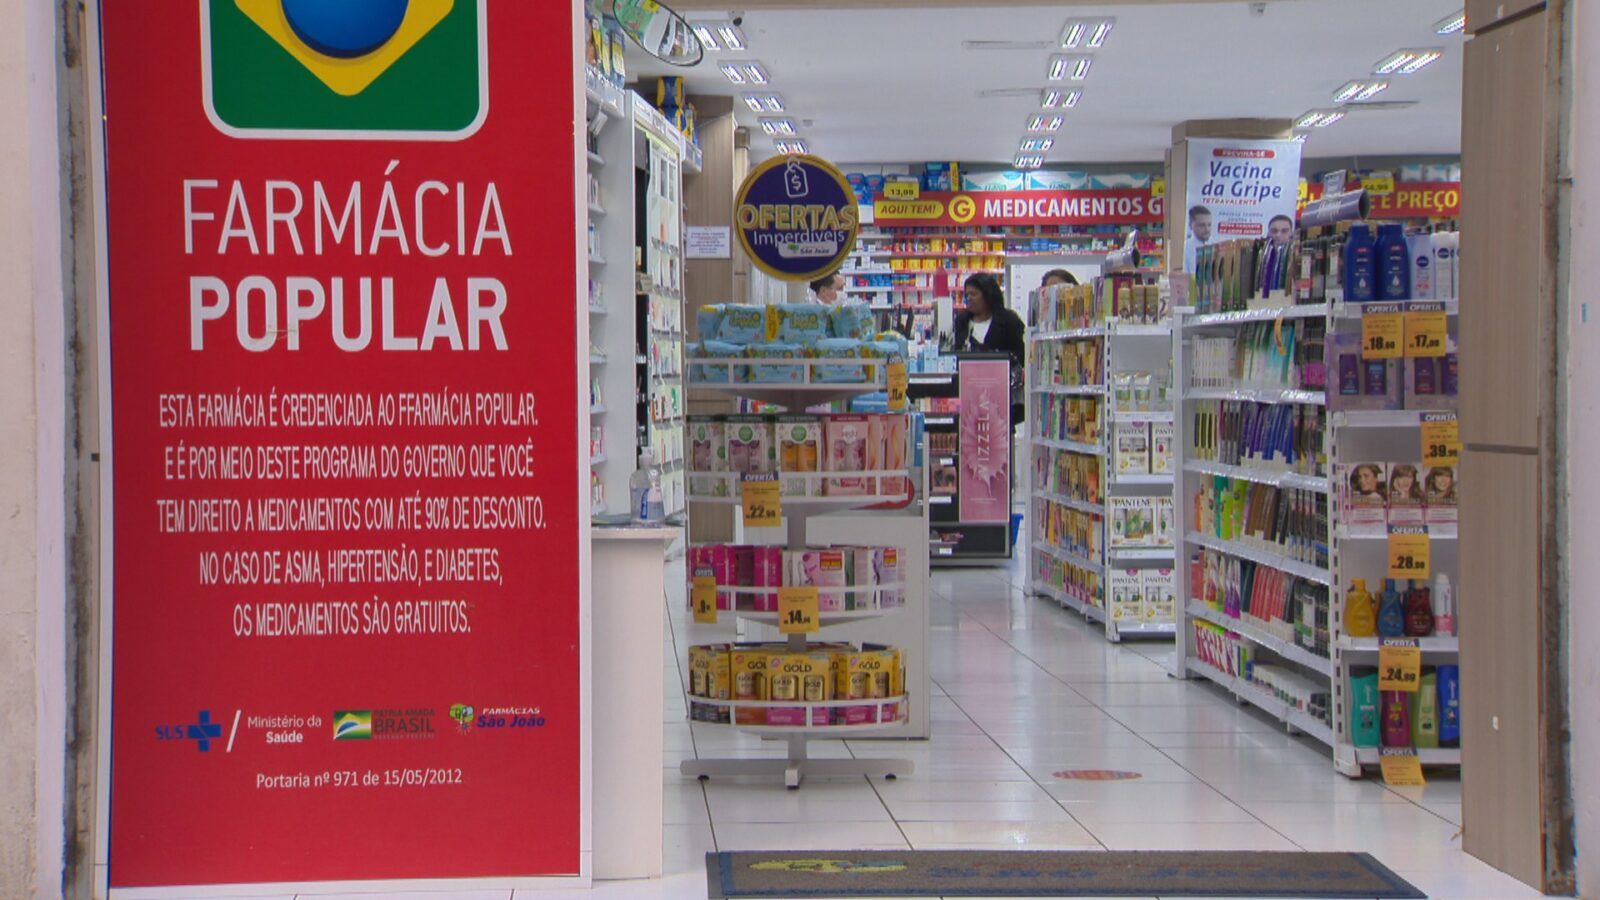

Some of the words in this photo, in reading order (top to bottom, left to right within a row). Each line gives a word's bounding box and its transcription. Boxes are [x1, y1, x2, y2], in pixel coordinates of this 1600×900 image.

[1222, 149, 1266, 158] PREVINA-SE
[1210, 161, 1272, 179] Vacina
[890, 188, 914, 197] 13,99
[1201, 179, 1225, 196] da
[1231, 180, 1282, 202] Gripe
[183, 159, 513, 257] FARMÁCIA
[983, 197, 1143, 218] MEDICAMENTOS
[1148, 197, 1165, 216] G
[1397, 190, 1458, 212] PREÇO
[880, 204, 908, 214] AQUI
[911, 203, 937, 214] TEM!
[953, 199, 971, 218] G
[737, 204, 857, 231] OFERTAS
[190, 275, 509, 352] POPULAR
[1367, 305, 1399, 313] OFERTA
[1410, 303, 1441, 311] OFERTA
[160, 394, 195, 427] ESTA
[199, 387, 266, 427] FARMÁCIA
[270, 387, 278, 427] É
[282, 394, 373, 426] CREDENCIADA
[378, 394, 395, 426] AO
[399, 387, 472, 426] FFARMÁCIA
[476, 393, 538, 426] POPULAR.
[1425, 413, 1457, 421] OFERTA
[165, 446, 174, 479] E
[178, 440, 186, 479] É
[190, 446, 217, 479] POR
[221, 446, 253, 479] MEIO
[257, 446, 300, 479] DESTE
[304, 446, 377, 479] PROGRAMA
[381, 445, 399, 478] DO
[404, 445, 466, 478] GOVERNO
[470, 445, 495, 478] QUE
[499, 437, 533, 477] VOCÊ
[745, 473, 775, 482] OFERTA
[1114, 498, 1151, 506] PANTENE
[157, 499, 185, 532] TEM
[189, 499, 241, 532] DIREITO
[245, 500, 254, 531] A
[258, 498, 360, 531] MEDICAMENTOS
[365, 498, 393, 530] COM
[398, 490, 422, 530] ATÉ
[426, 497, 449, 529] 90%
[453, 497, 469, 529] DE
[474, 496, 546, 529] DESCONTO.
[1392, 526, 1424, 534] OFERTA
[200, 552, 218, 584] NO
[223, 551, 259, 584] CASO
[264, 551, 280, 584] DE
[285, 551, 324, 588] ASMA,
[328, 543, 421, 586] HIPERTENSÃO,
[425, 549, 432, 581] E
[436, 548, 502, 586] DIABETES,
[233, 603, 252, 636] OS
[256, 602, 359, 636] MEDICAMENTOS
[363, 595, 390, 634] SÃO
[394, 600, 470, 633] GRATUITOS.
[1384, 639, 1416, 647] OFERTA
[747, 661, 767, 669] GOL
[783, 664, 812, 673] GOLD
[859, 661, 881, 670] GOLD
[482, 706, 541, 715] FARMÁCIAS
[248, 715, 304, 728] Ministério
[307, 715, 322, 728] da
[374, 717, 435, 734] BRASIL
[477, 714, 505, 728] São
[510, 714, 545, 728] João
[155, 724, 184, 740] SUS
[266, 730, 304, 743] Saúde
[257, 771, 311, 789] Portaria
[334, 771, 358, 787] 971
[363, 769, 380, 786] de
[384, 768, 463, 787] 15/05/2012
